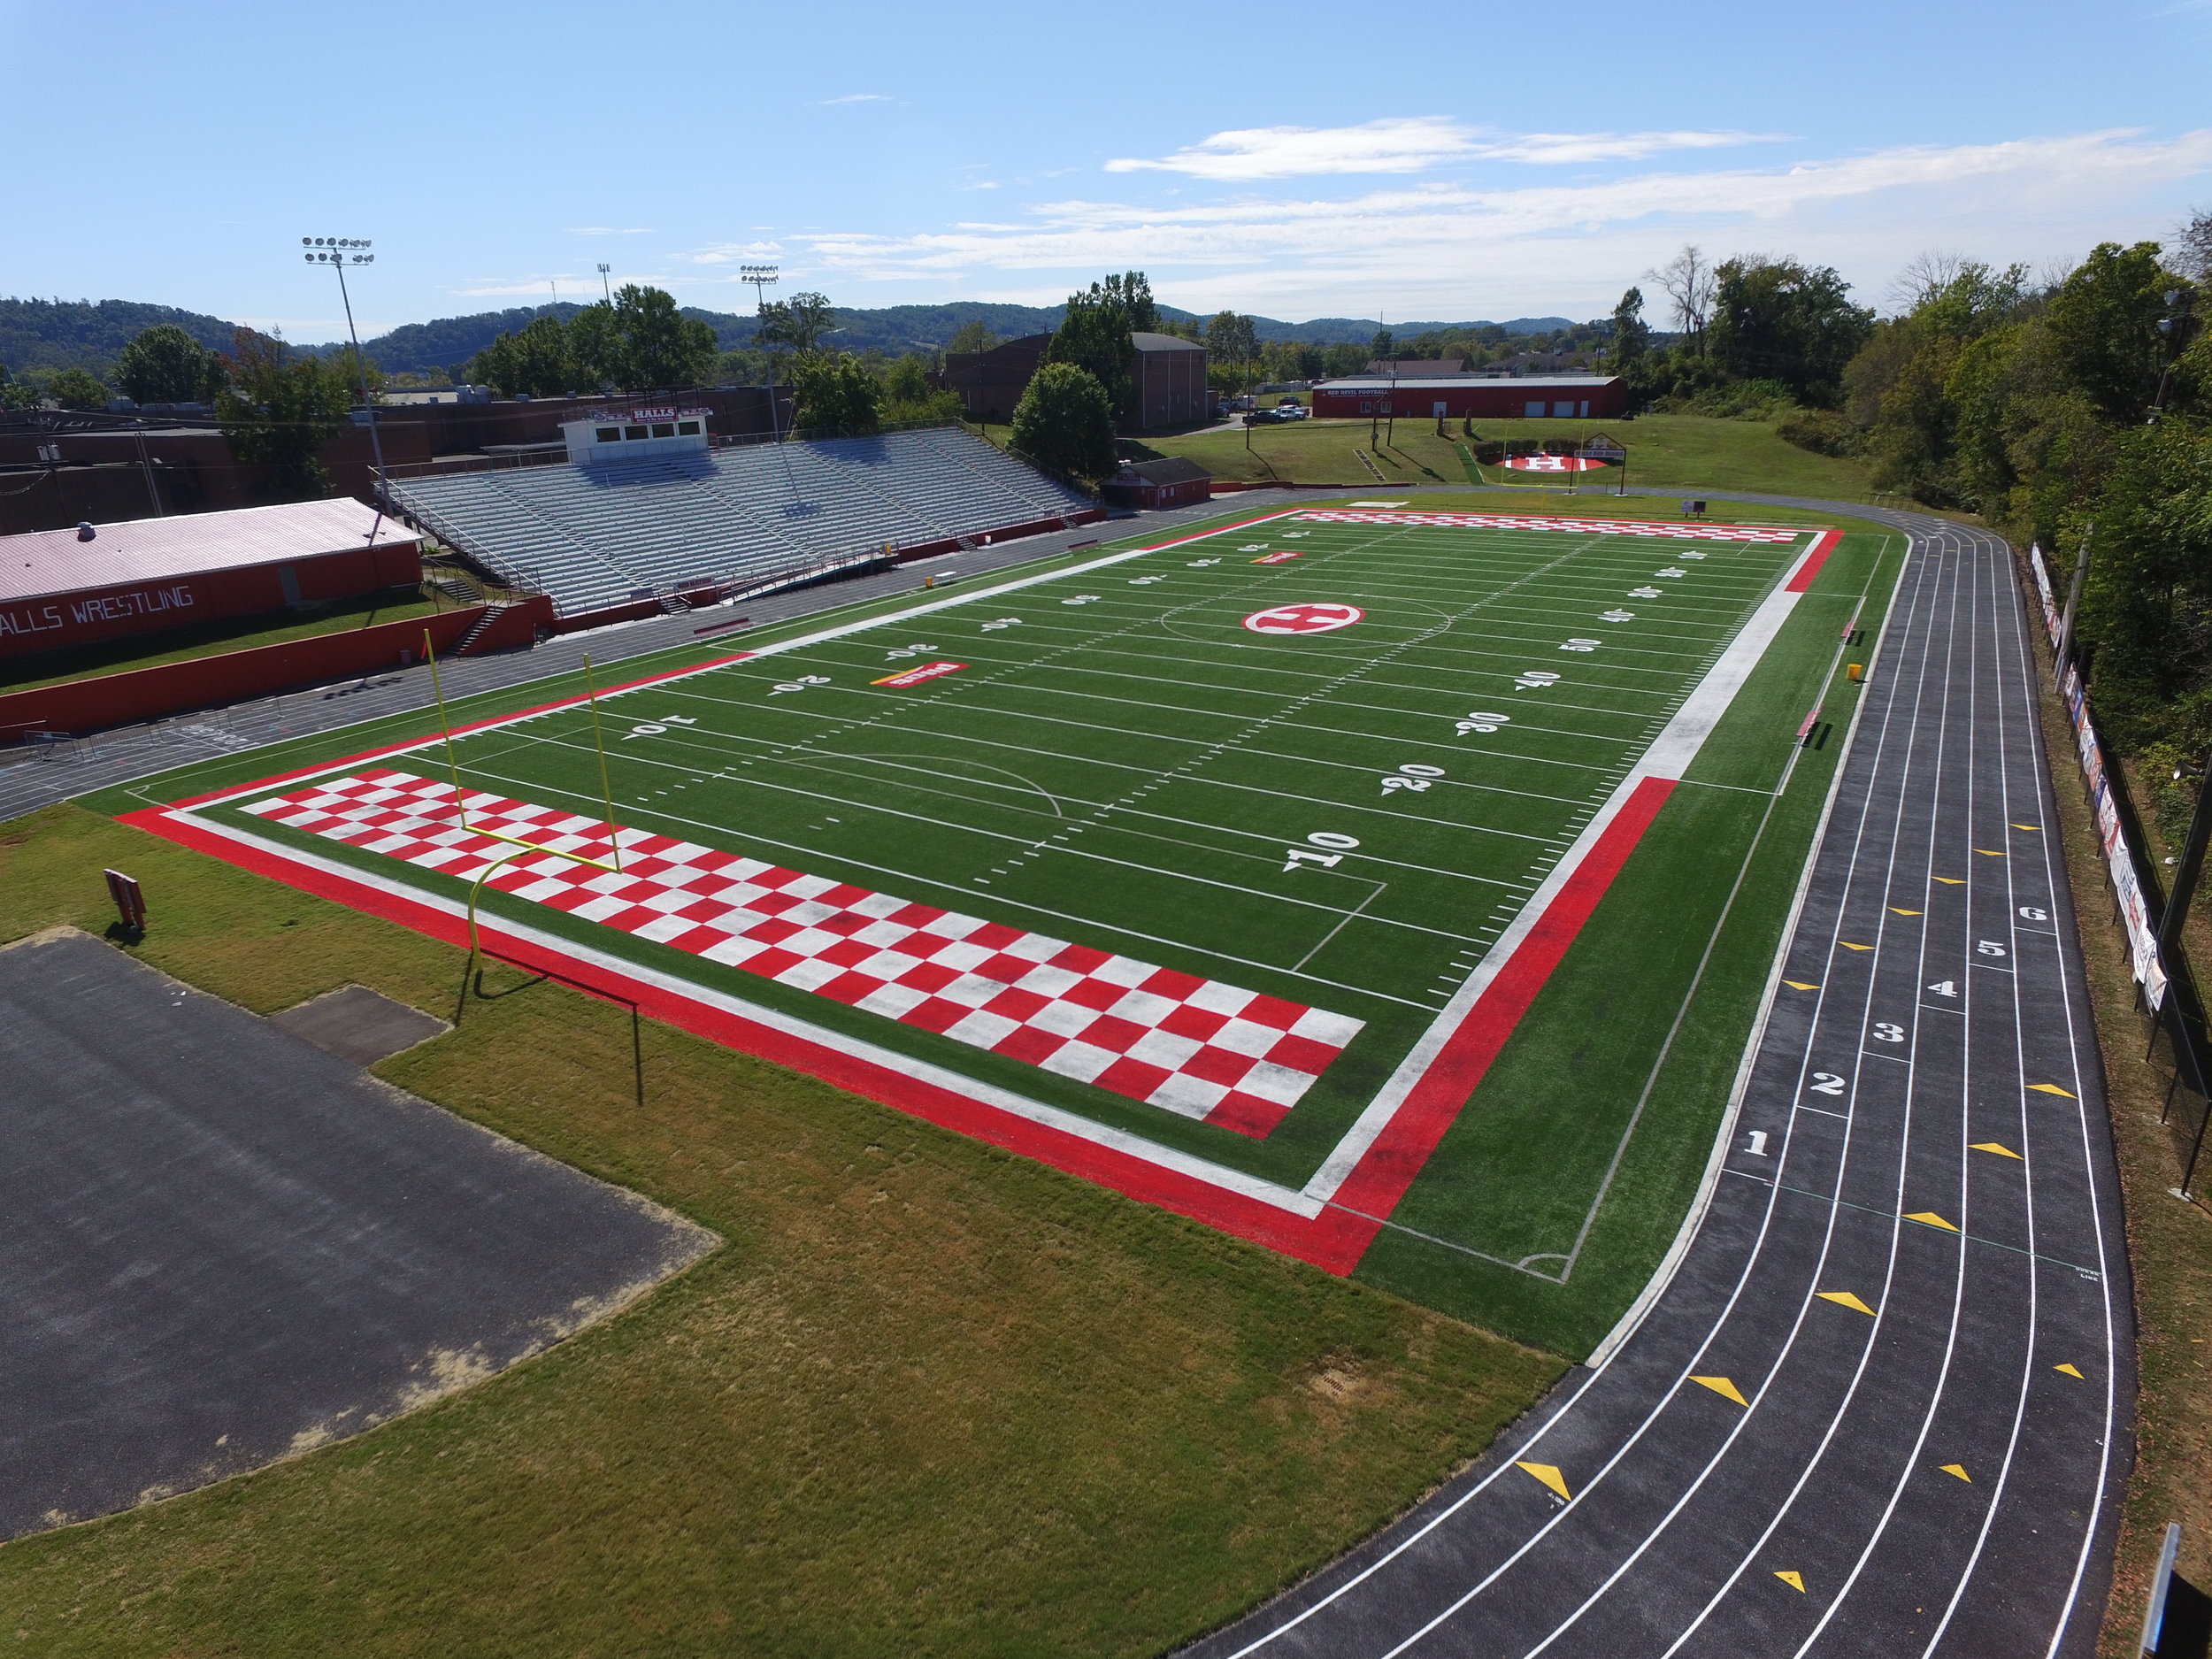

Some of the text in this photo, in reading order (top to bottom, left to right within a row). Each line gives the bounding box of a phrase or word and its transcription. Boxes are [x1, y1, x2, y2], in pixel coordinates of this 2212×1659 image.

[634, 409, 674, 418] HALLS
[1525, 457, 1565, 470] H
[70, 585, 195, 624] WRESTLING
[1558, 638, 1602, 652] 50
[773, 675, 832, 692] 20
[1514, 671, 1561, 687] 40
[633, 715, 698, 734] 10
[1455, 711, 1510, 733] 30
[1381, 764, 1446, 792] 20
[1286, 832, 1360, 868] 10
[2018, 906, 2047, 921] 6
[1977, 940, 2006, 956] 5
[1927, 980, 1958, 998] 4
[1873, 1022, 1904, 1042] 3
[1810, 1072, 1845, 1095] 2
[1744, 1130, 1768, 1156] 1
